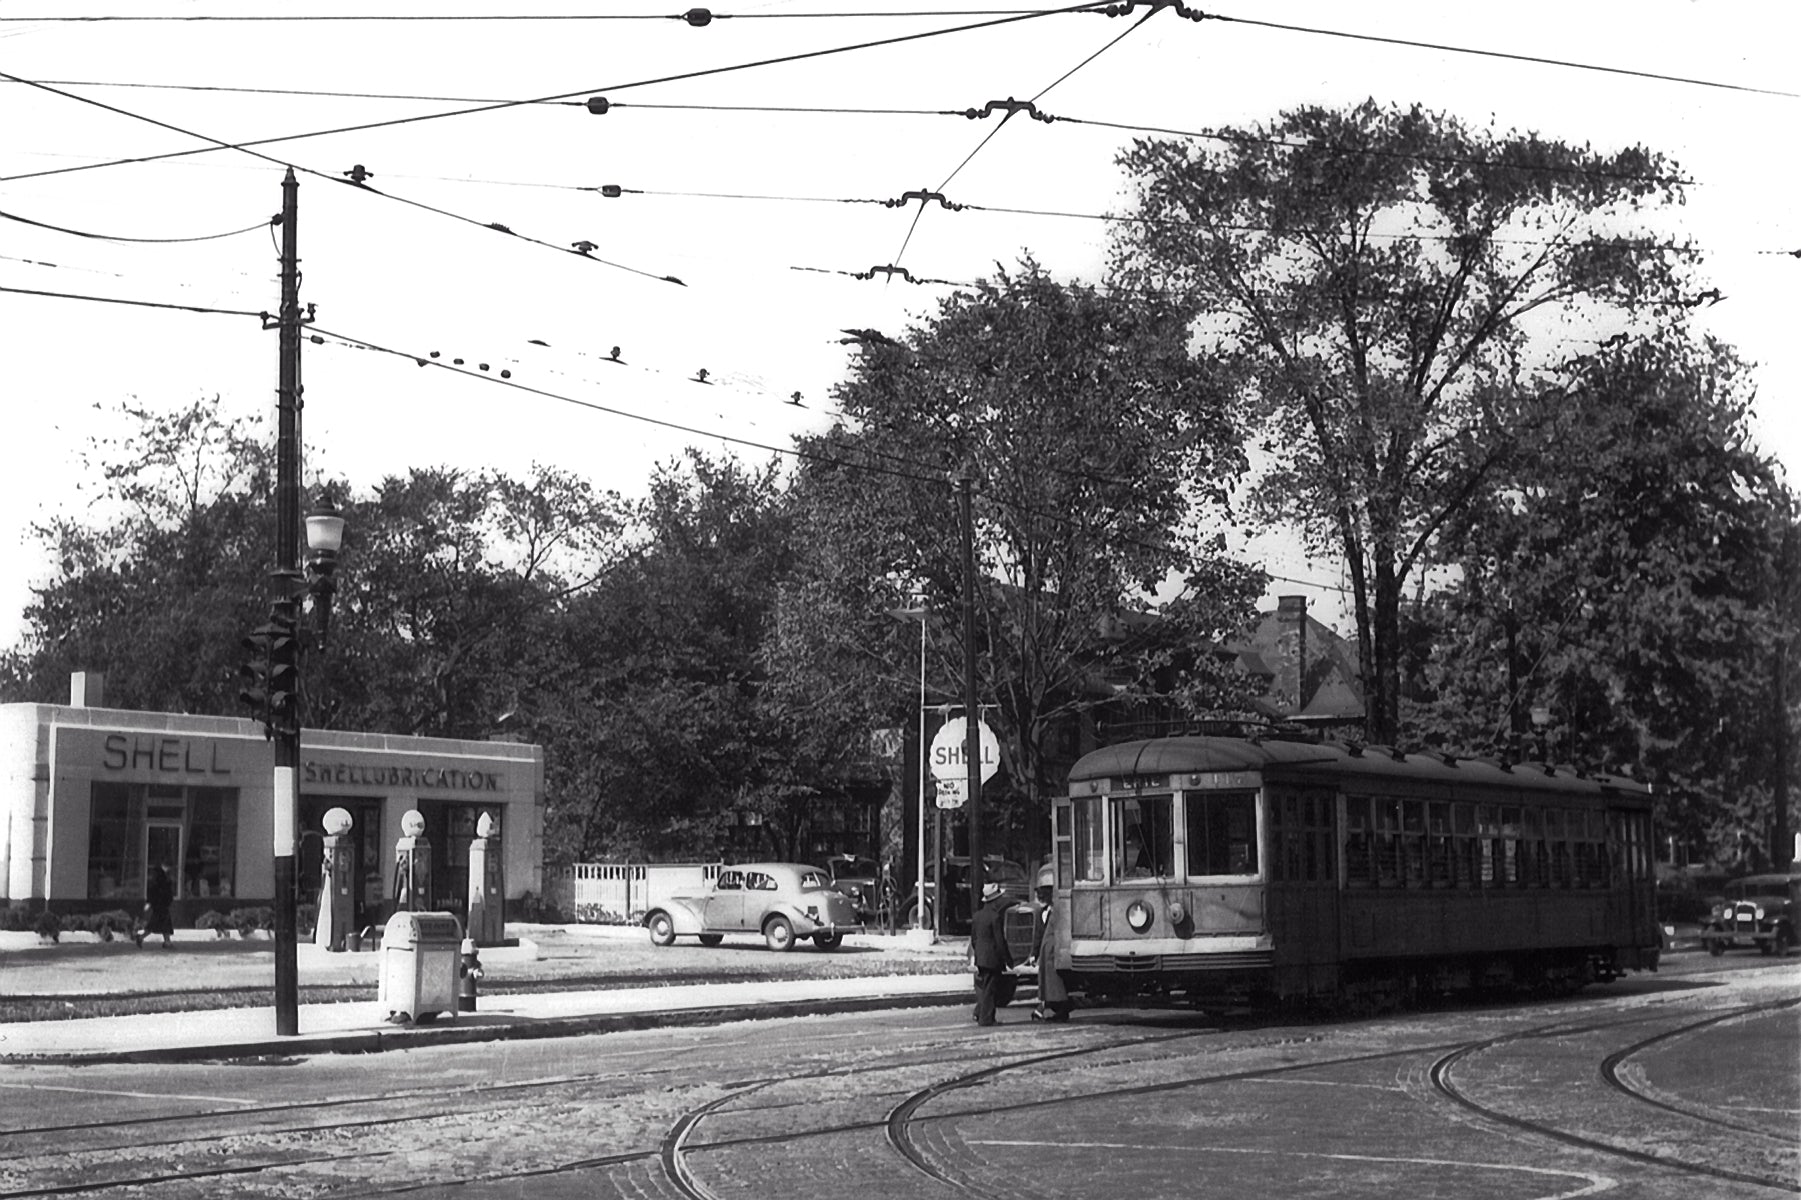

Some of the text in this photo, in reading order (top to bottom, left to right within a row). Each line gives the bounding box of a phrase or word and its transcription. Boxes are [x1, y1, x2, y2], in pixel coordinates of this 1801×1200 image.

[103, 735, 231, 774] SHELL
[935, 746, 994, 765] SHL
[304, 761, 497, 791] SHELLUBRICATION
